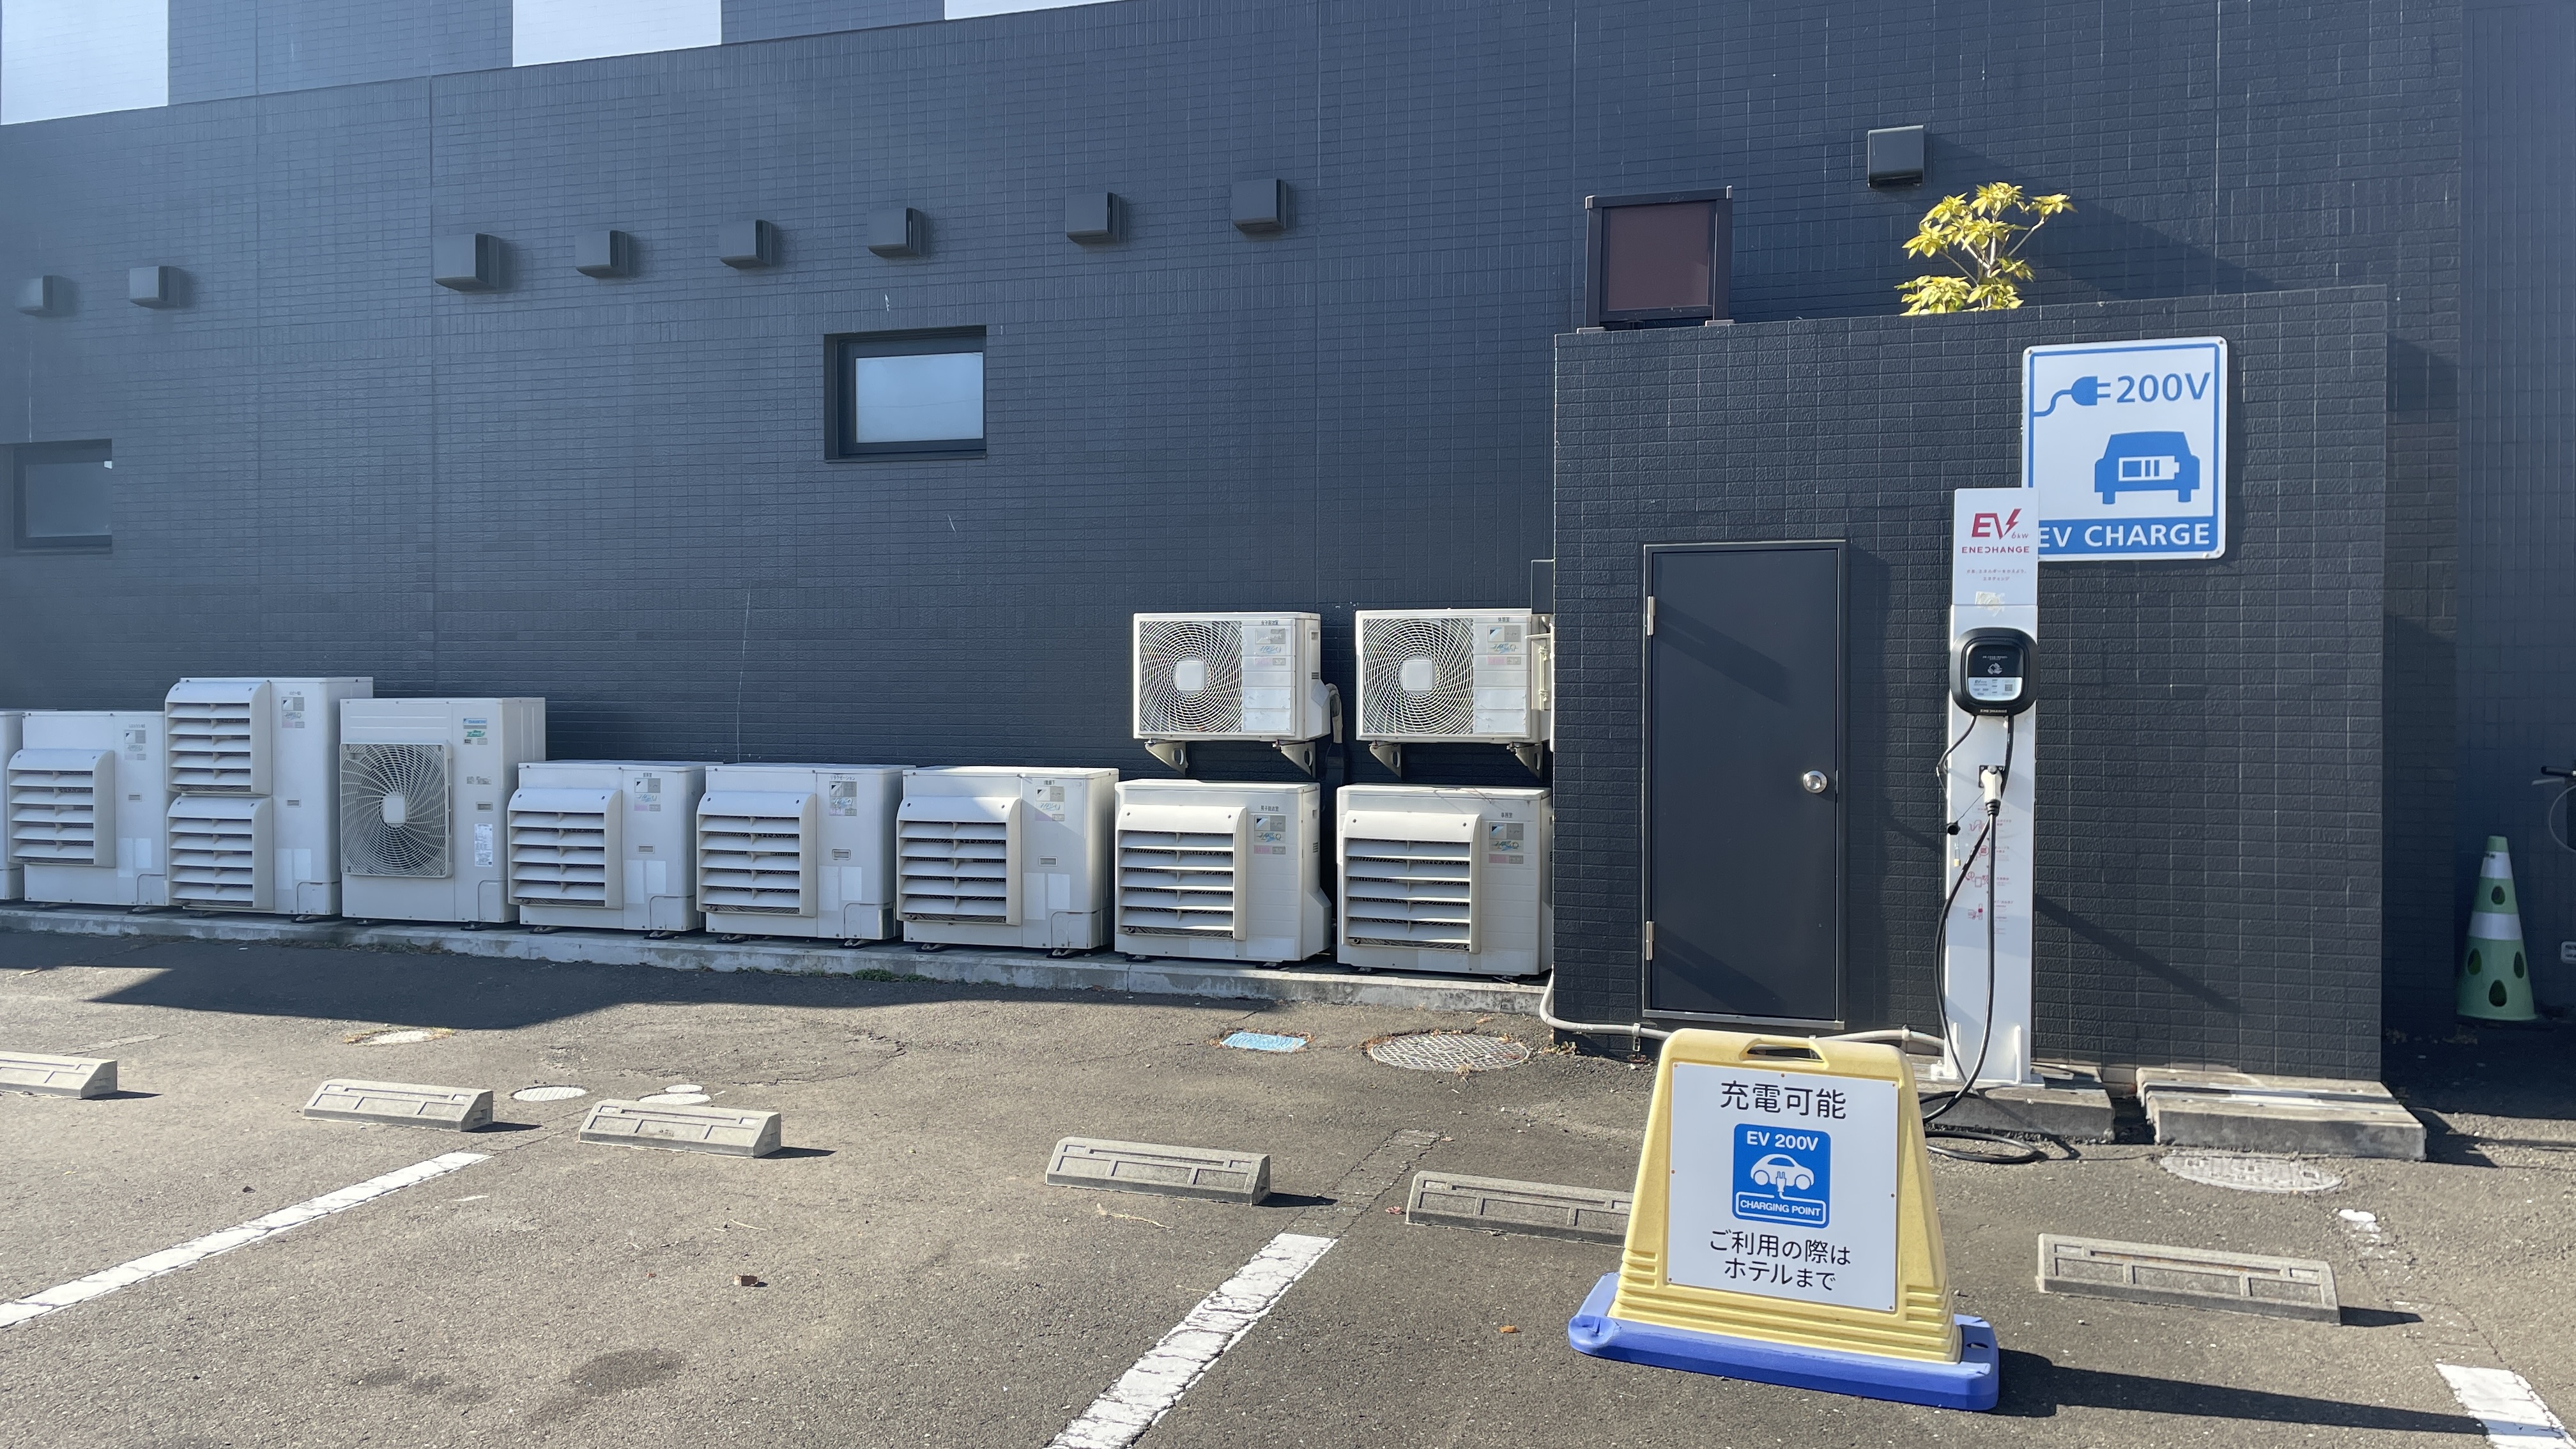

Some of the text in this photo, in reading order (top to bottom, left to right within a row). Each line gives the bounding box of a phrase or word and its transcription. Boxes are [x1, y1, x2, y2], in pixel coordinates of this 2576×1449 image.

[2117, 372, 2211, 403] 200V
[1972, 509, 2022, 540] EV
[2038, 523, 2210, 548] EV CHARGE
[1720, 1080, 1846, 1119] 充電可能
[1746, 1130, 1819, 1151] EV 200V
[1740, 1199, 1821, 1216] CHARGING POINT
[1710, 1229, 1851, 1265] ご利用の際は
[1724, 1257, 1836, 1291] ホテルまで
